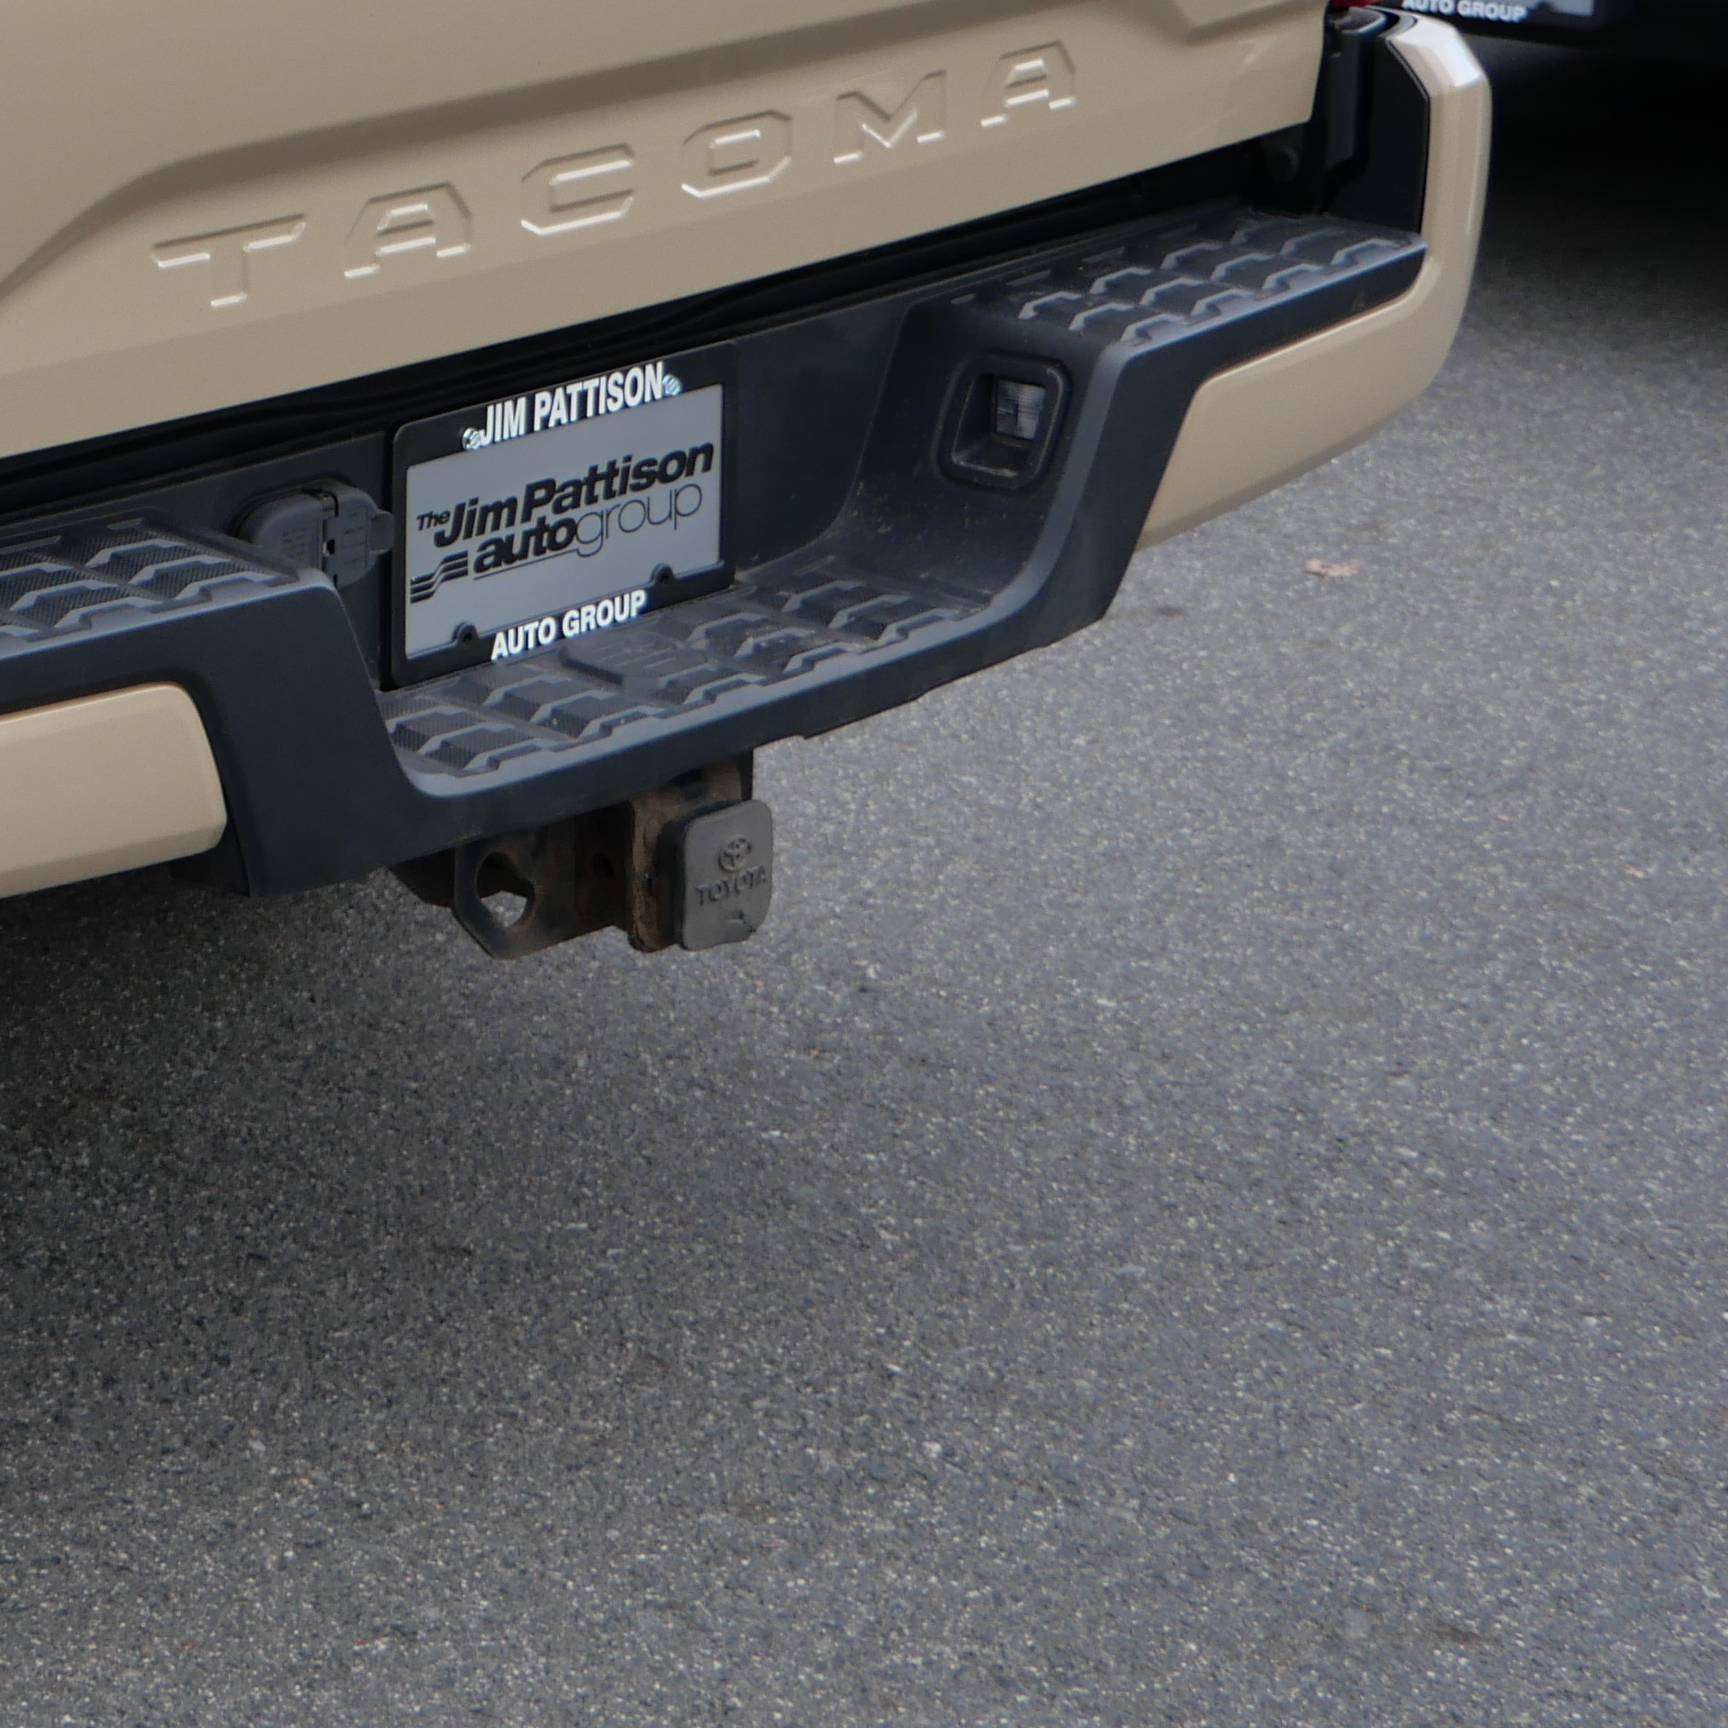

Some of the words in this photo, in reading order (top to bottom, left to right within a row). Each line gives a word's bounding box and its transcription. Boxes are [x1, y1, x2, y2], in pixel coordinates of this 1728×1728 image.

[1457, 0, 1527, 22] GROUP
[151, 40, 1077, 307] TACOMA
[480, 396, 526, 446] JIM
[533, 362, 665, 431] PATTISON
[416, 507, 451, 531] The
[520, 442, 714, 524] Pattison
[491, 617, 557, 660] AUTO
[562, 589, 647, 637] GROUP
